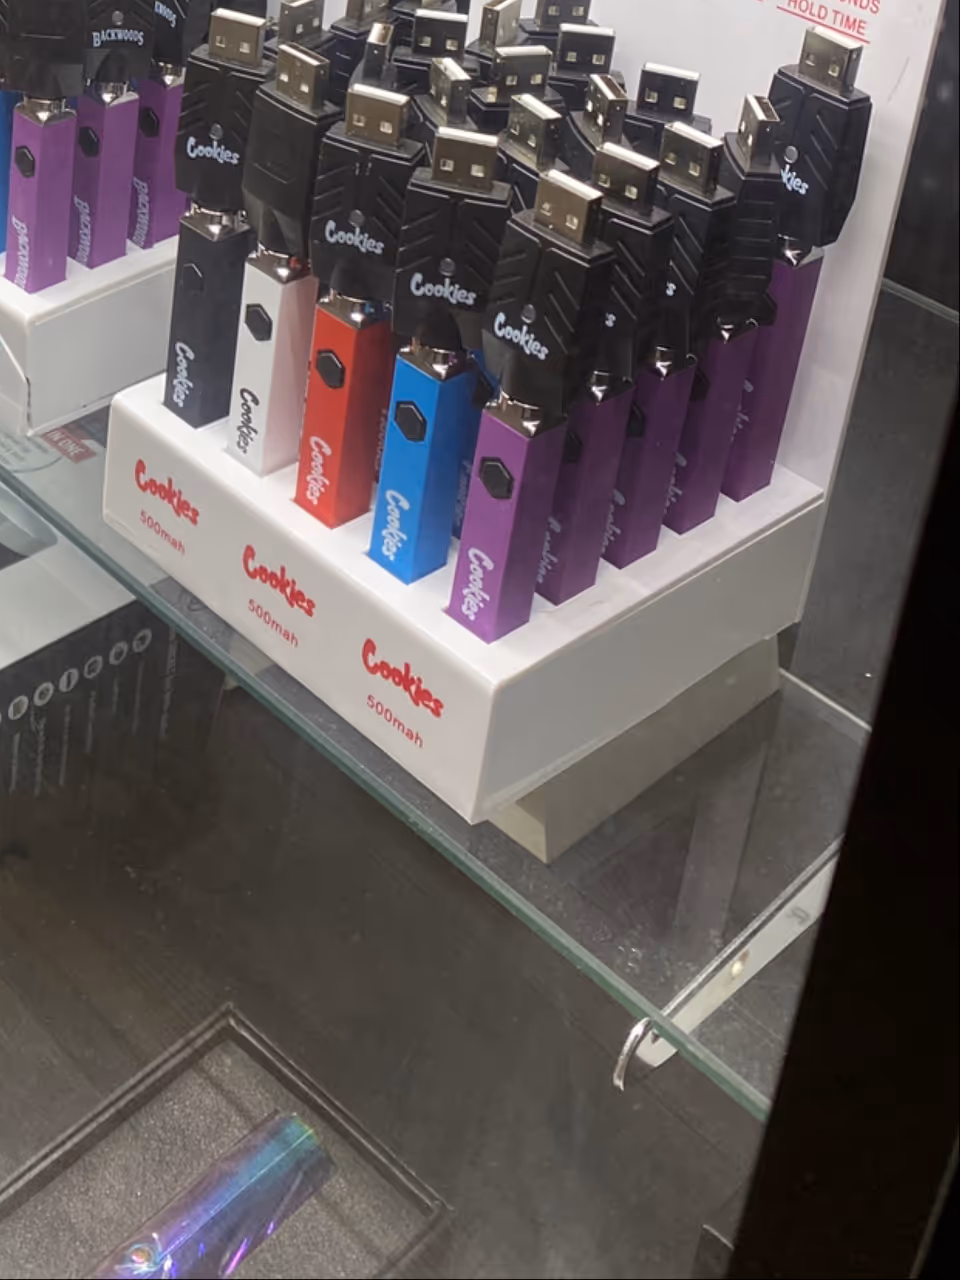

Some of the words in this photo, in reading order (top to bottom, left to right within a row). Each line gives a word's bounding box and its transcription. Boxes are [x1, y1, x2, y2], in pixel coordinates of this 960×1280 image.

[93, 29, 145, 48] BACKWOODS
[833, 10, 868, 36] TIME
[186, 136, 241, 166] Cookies
[325, 220, 385, 256] Cookies
[410, 272, 477, 307] Cookies
[494, 311, 549, 361] Cookies
[174, 340, 195, 408] Cookies
[236, 387, 261, 456] Cookies
[134, 458, 200, 527] Cookies
[306, 435, 332, 506] Cookies
[139, 509, 186, 556] 500mah
[381, 489, 409, 561] Cookies
[242, 544, 317, 618] Cookies
[461, 547, 494, 621] Cookies
[247, 598, 299, 649] 500mah
[361, 637, 445, 719] Cookies
[366, 693, 424, 749] 500mah
